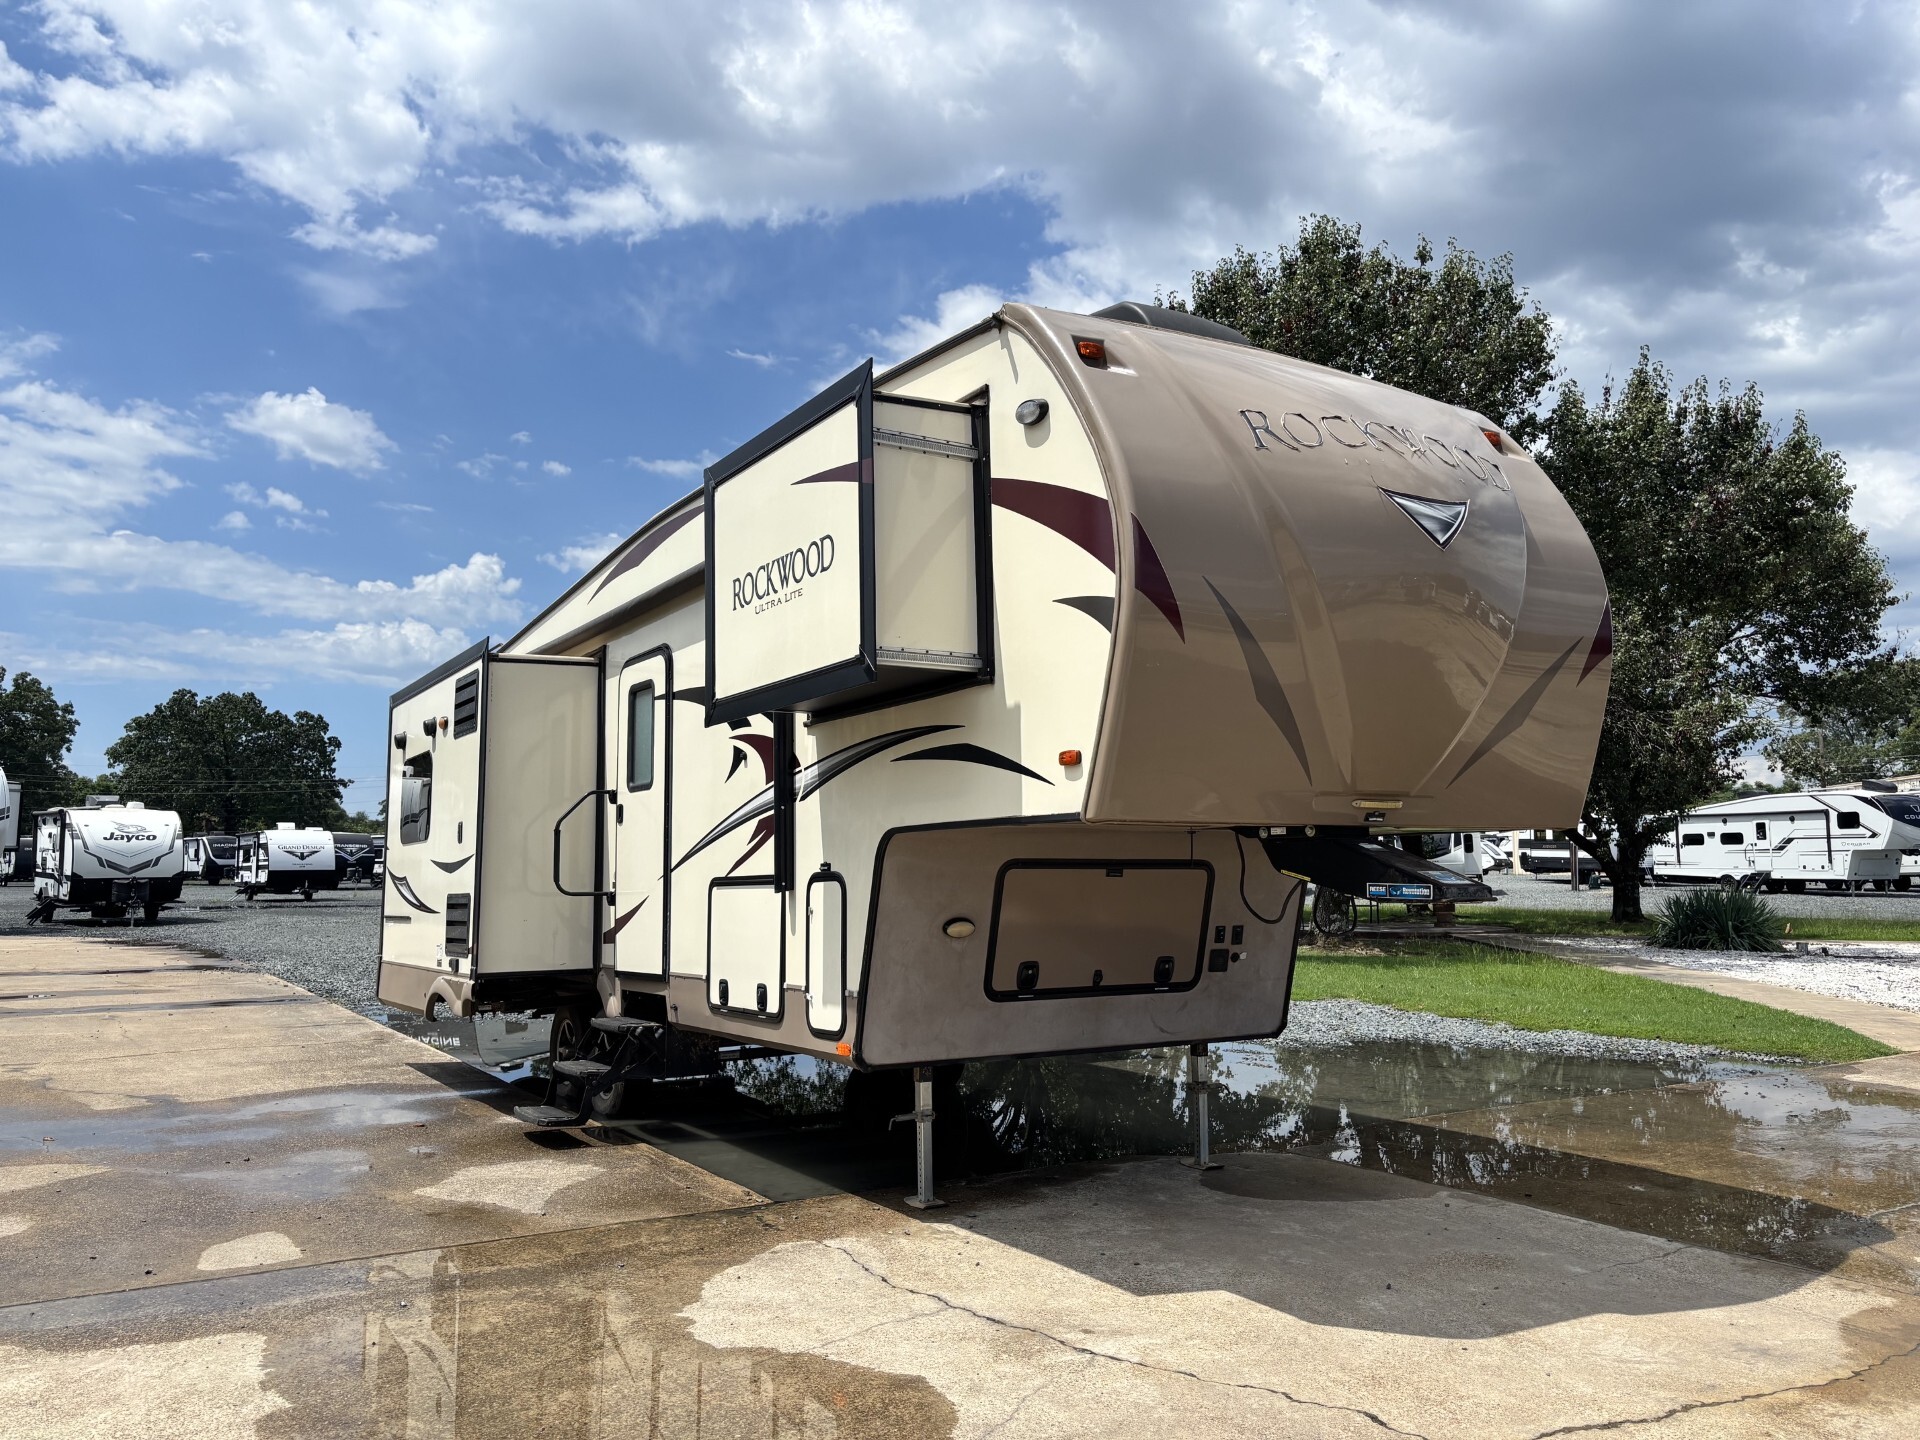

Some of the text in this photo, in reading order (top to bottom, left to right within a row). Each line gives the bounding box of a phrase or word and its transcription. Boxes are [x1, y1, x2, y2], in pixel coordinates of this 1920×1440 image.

[1238, 408, 1510, 492] ROCKWOOD
[732, 534, 835, 611] ROCKWOOD
[754, 587, 804, 615] ULTRA LITE
[103, 832, 157, 843] Jayco
